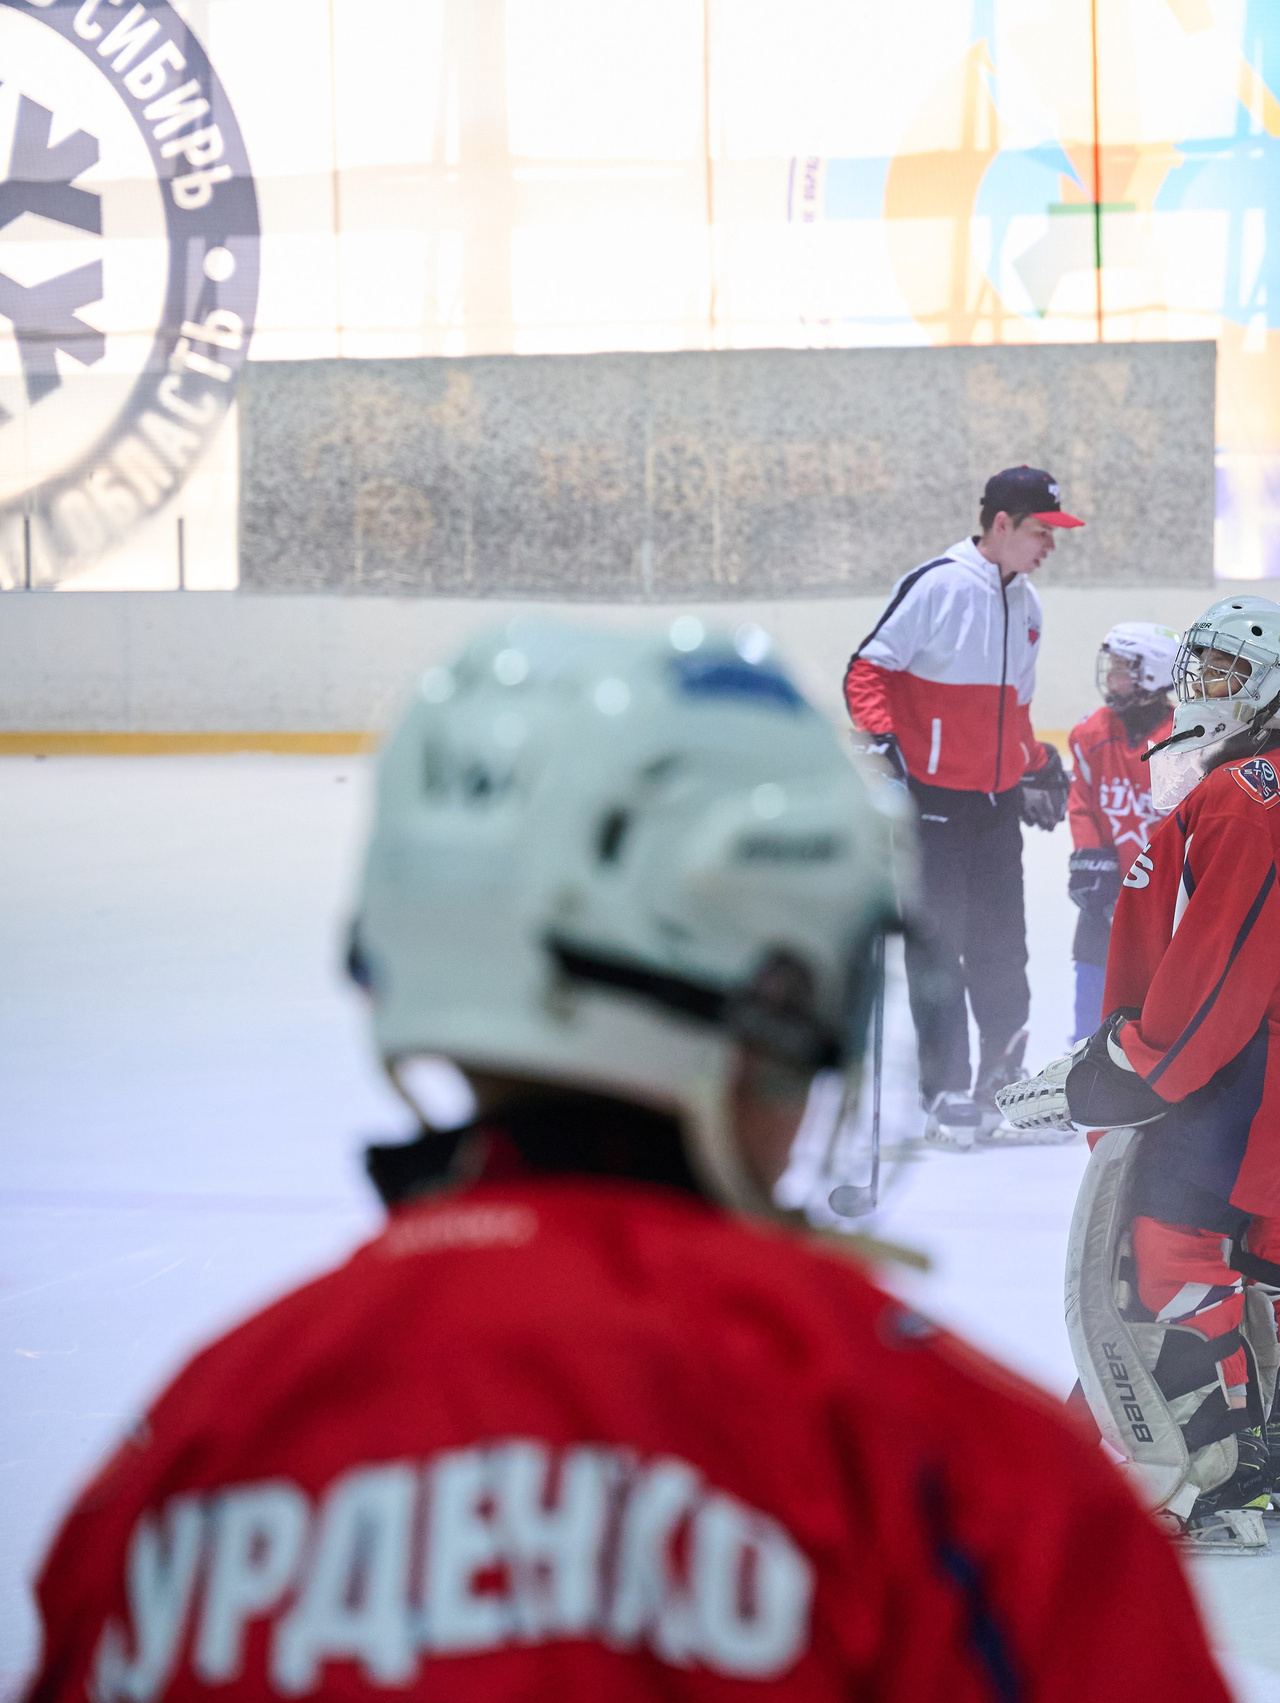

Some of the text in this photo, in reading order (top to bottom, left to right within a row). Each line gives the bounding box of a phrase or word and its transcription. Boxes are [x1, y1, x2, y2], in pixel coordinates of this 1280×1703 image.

[1253, 761, 1274, 781] 10
[1102, 1341, 1154, 1443] BAUER
[84, 1437, 817, 1703] УРДЕНКО
